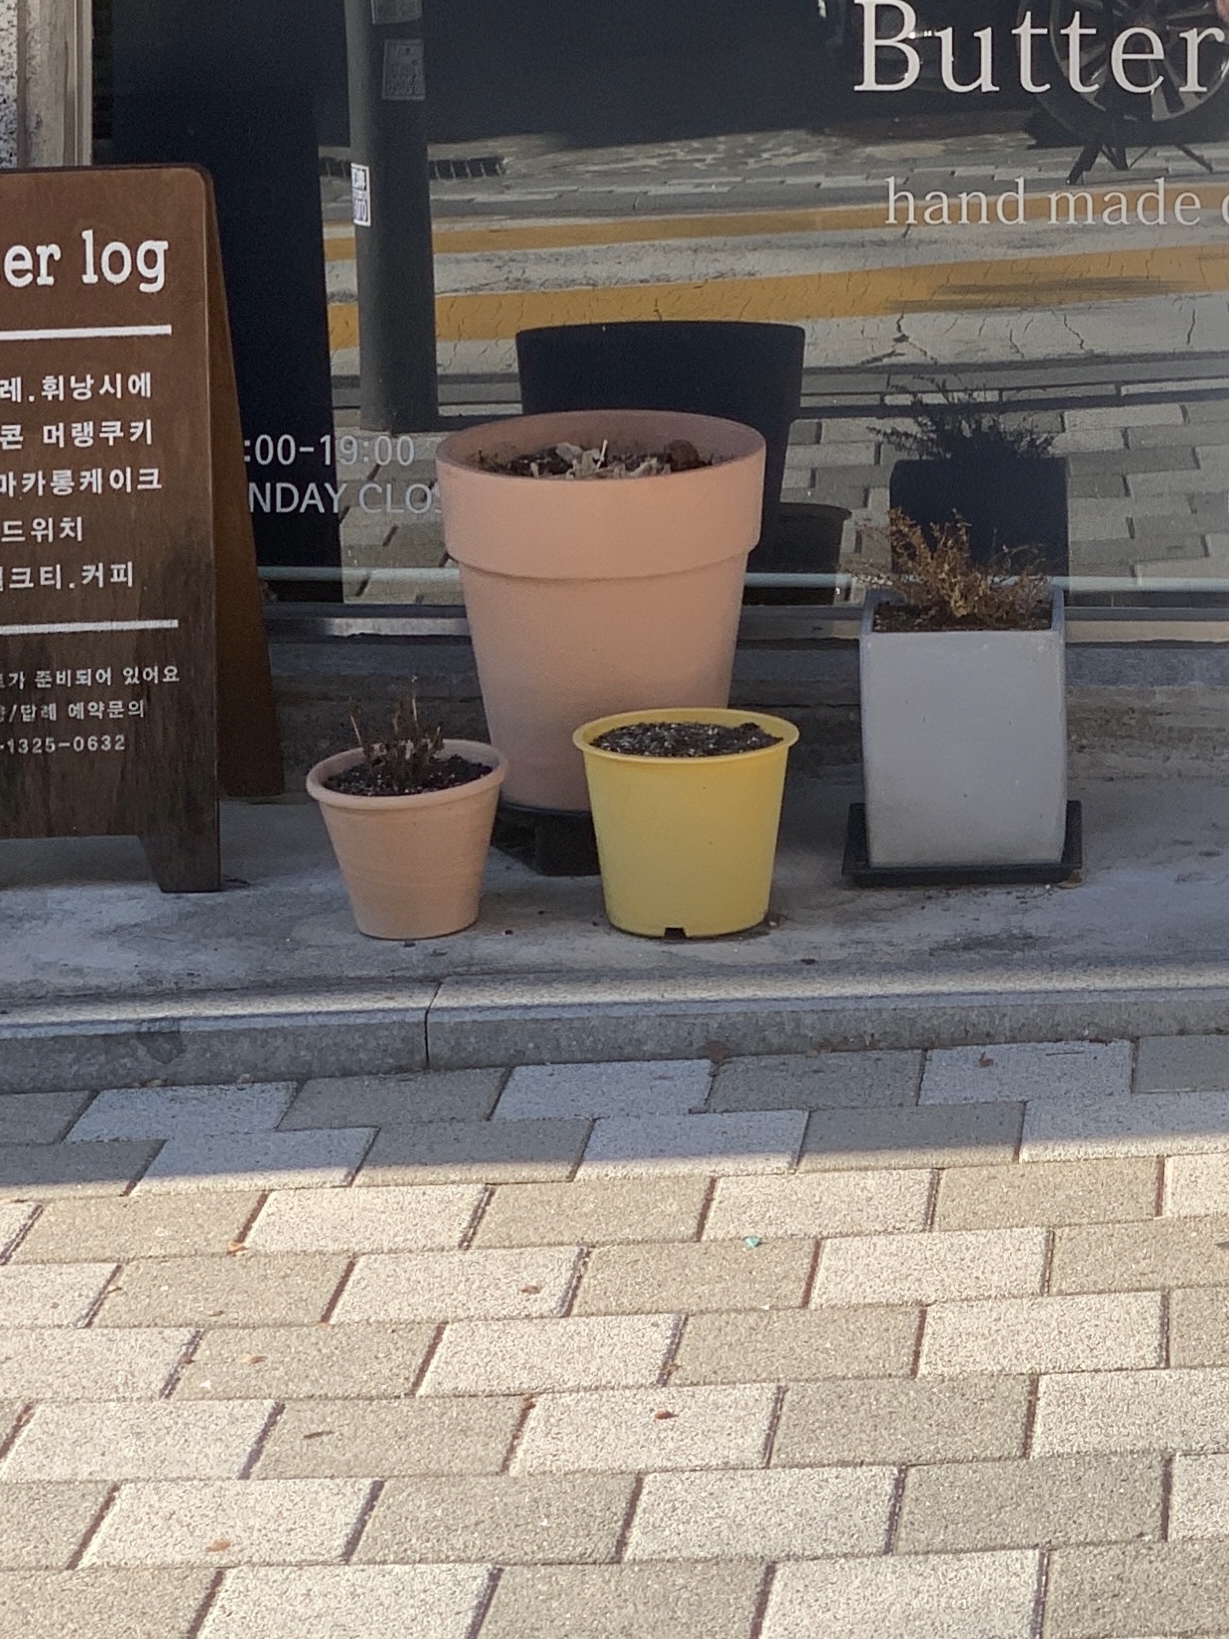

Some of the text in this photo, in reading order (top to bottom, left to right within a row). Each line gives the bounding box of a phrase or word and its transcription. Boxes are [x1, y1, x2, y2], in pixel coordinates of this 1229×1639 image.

[885, 176, 1027, 226] hand
[1047, 178, 1202, 226] made
[4, 229, 169, 294] er log
[42, 418, 152, 448] 머랭쿠키
[248, 481, 442, 514] NDAY CLO
[1, 516, 83, 543] 드위치
[0, 561, 134, 592] 크티.커피
[34, 666, 112, 688] 준비되어
[122, 665, 180, 685] 있어요
[68, 699, 145, 720] 예약문의
